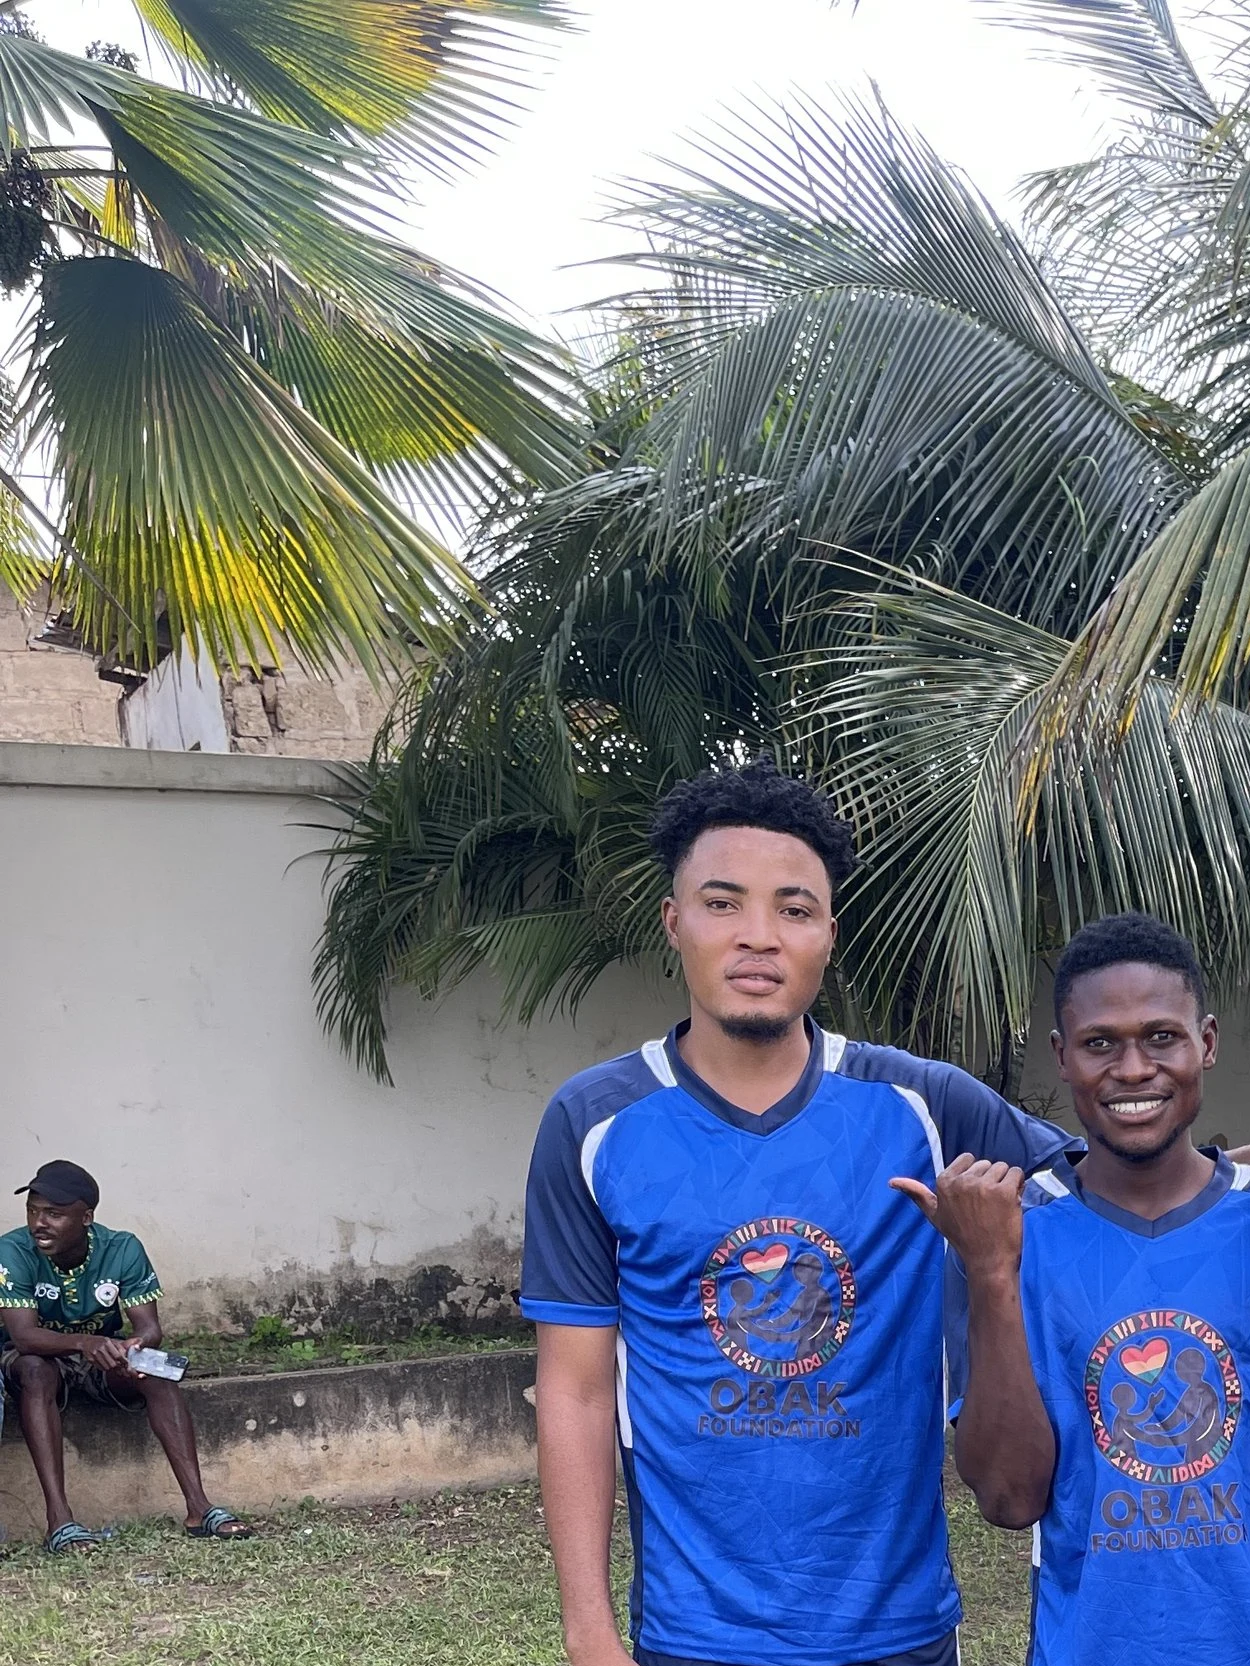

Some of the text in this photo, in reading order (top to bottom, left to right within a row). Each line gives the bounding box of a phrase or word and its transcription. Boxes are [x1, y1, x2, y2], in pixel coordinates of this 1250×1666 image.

[710, 1378, 848, 1416] OBAK
[697, 1415, 861, 1439] FOUNDATION
[1101, 1482, 1242, 1529] OBAK
